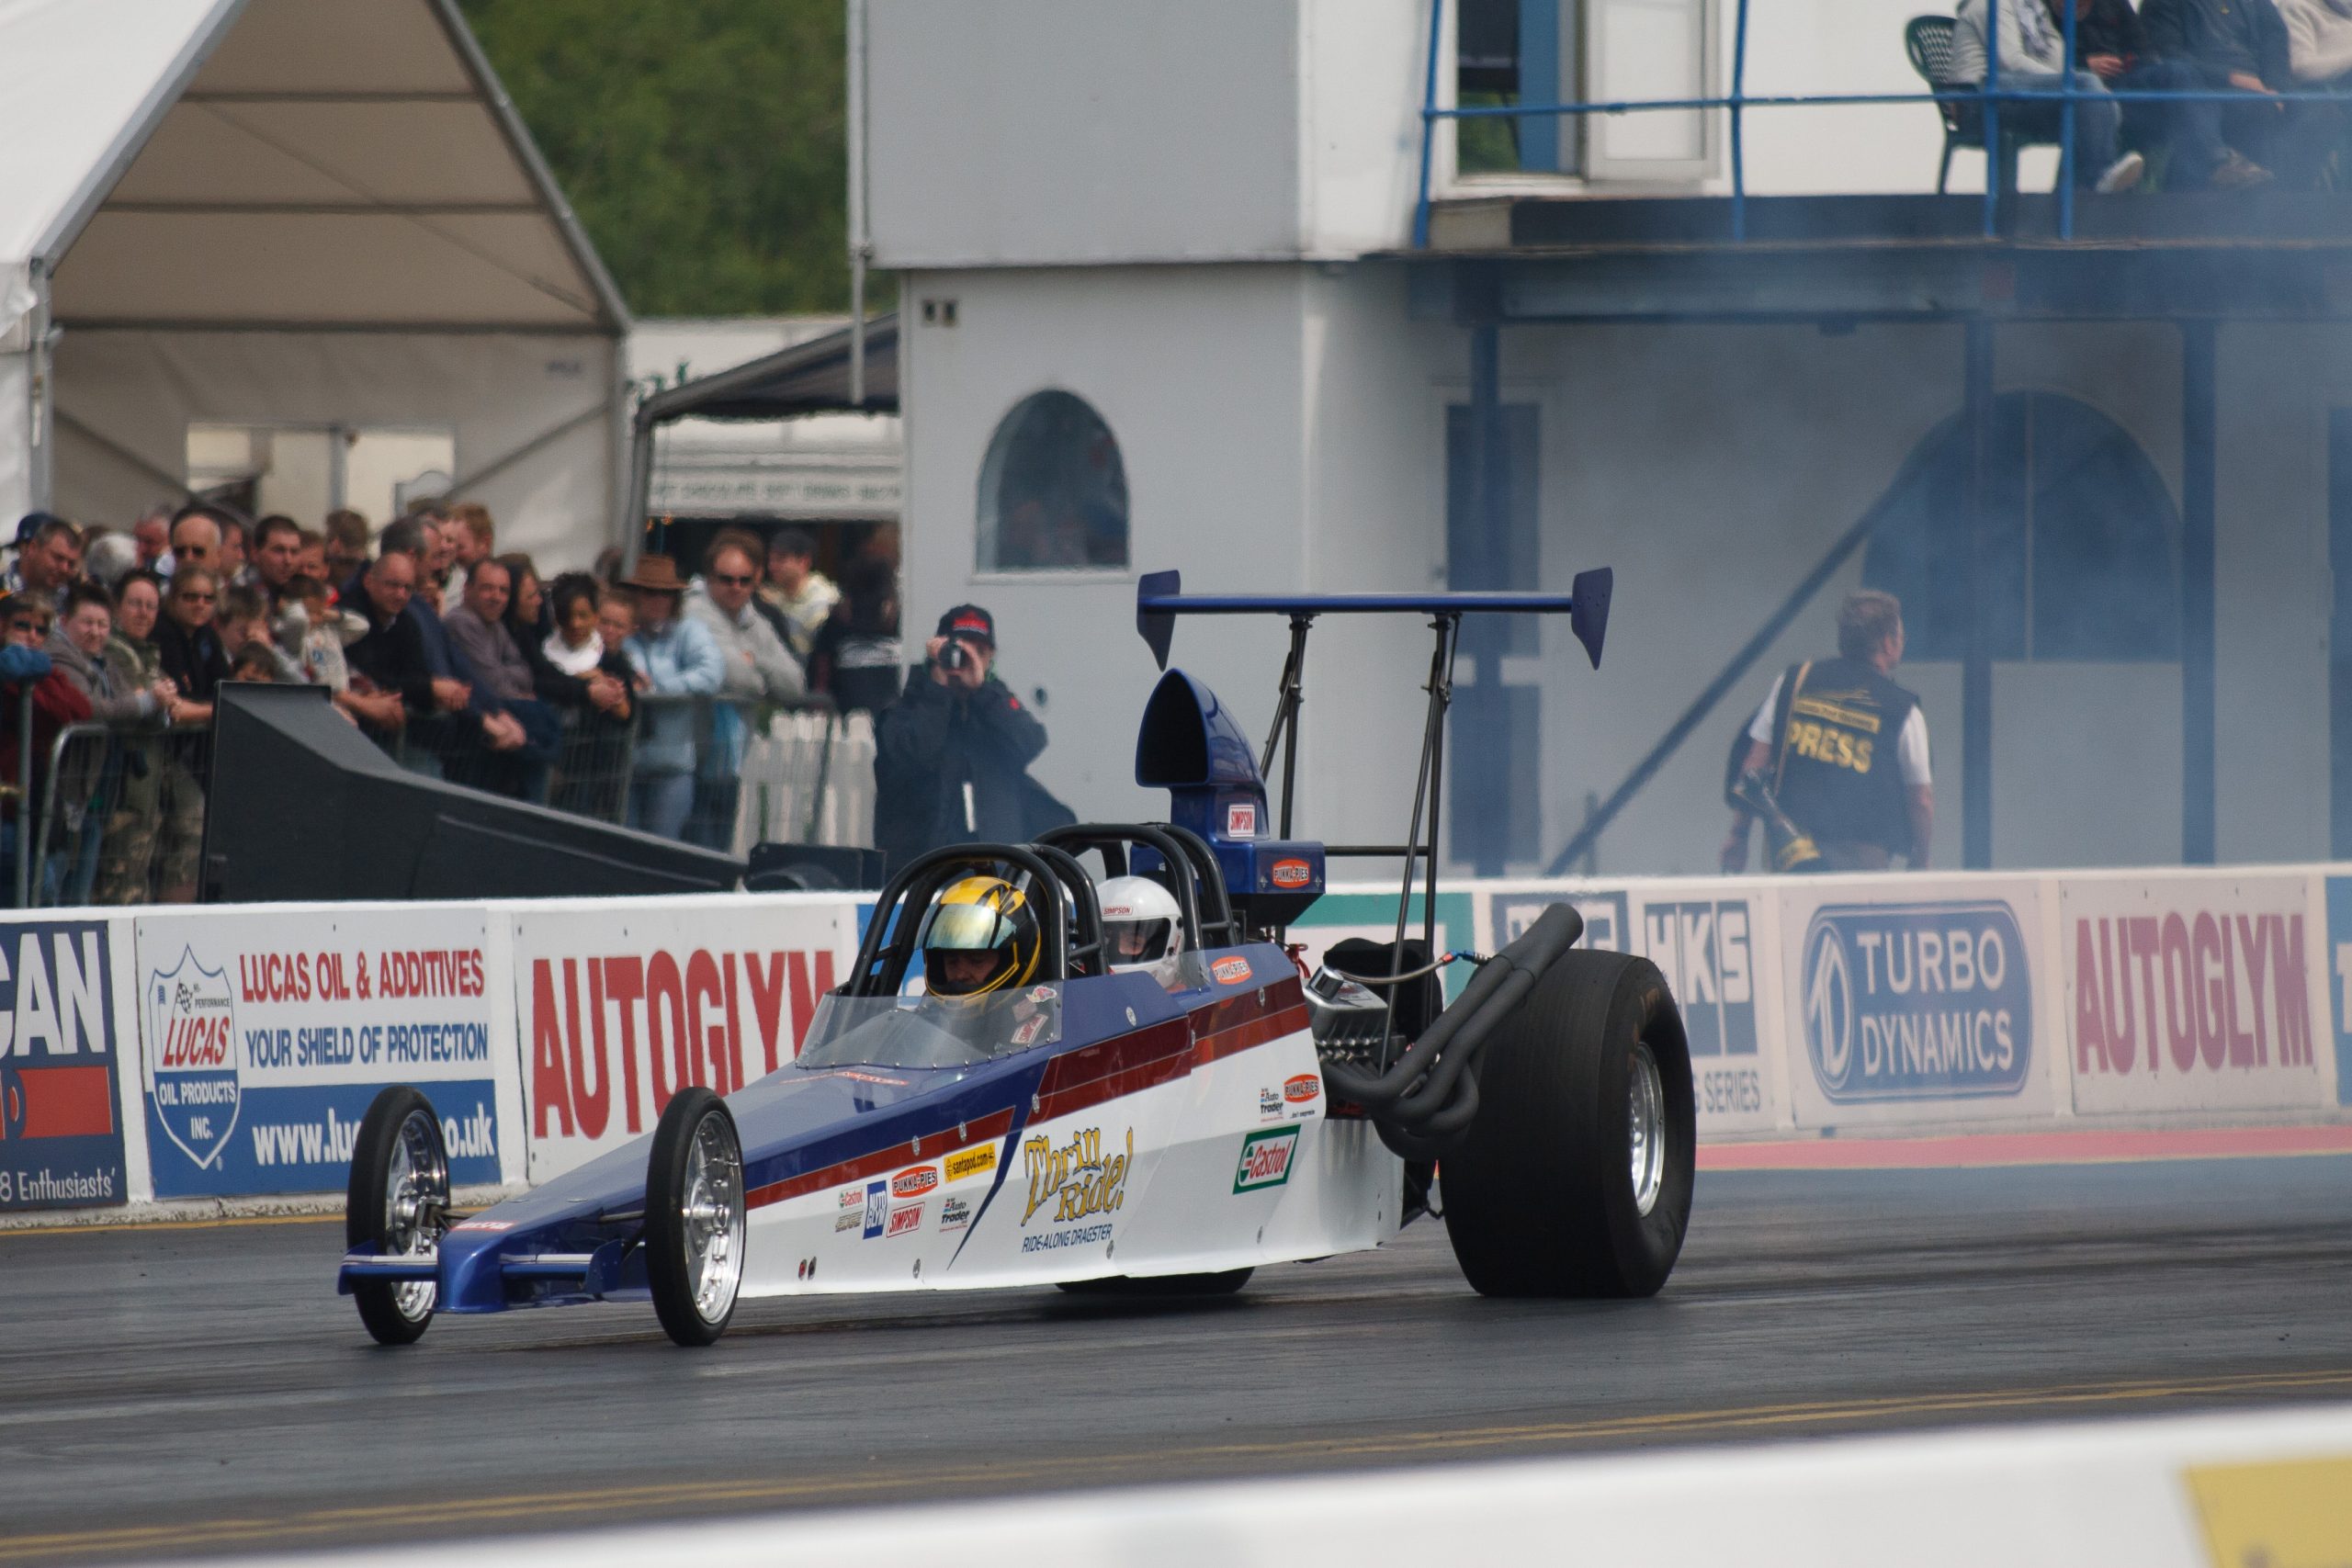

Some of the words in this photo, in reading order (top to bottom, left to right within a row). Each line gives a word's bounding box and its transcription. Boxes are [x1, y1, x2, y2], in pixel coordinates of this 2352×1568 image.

[1791, 721, 1872, 773] PRESS
[1230, 810, 1253, 831] SIMPSON
[1103, 906, 1131, 916] SIMPSON
[240, 952, 311, 1003] LUCAS
[316, 952, 351, 1002] OIL
[356, 950, 371, 1001] &
[379, 947, 486, 999] ADDITIVES
[1645, 910, 1752, 1005] HKS
[1856, 927, 2007, 996] TURBO
[194, 997, 231, 1010] PERFORMANCE
[2075, 910, 2314, 1076] AUTOGLYM
[162, 1015, 231, 1067] LUCAS
[244, 1026, 293, 1068] YOUR
[297, 1026, 355, 1067] SHIELD
[358, 1025, 383, 1064] OF
[388, 1021, 489, 1063] PROTECTION
[1861, 1009, 2015, 1077] DYNAMICS
[158, 1082, 178, 1106] OIL
[180, 1081, 237, 1105] PRODUCTS
[1704, 1070, 1761, 1114] SERIES
[189, 1117, 213, 1140] INC.
[953, 1152, 988, 1176] santapod.com
[1021, 1127, 1102, 1227] Thrill
[1054, 1125, 1133, 1223] Ride!
[1249, 1139, 1292, 1179] Castrol
[844, 1190, 863, 1207] Castrol
[941, 1211, 970, 1224] Trader
[888, 1206, 922, 1234] SIMPSON
[1022, 1228, 1071, 1253] RIDE-ALONG
[1069, 1224, 1114, 1247] DRAGSTER
